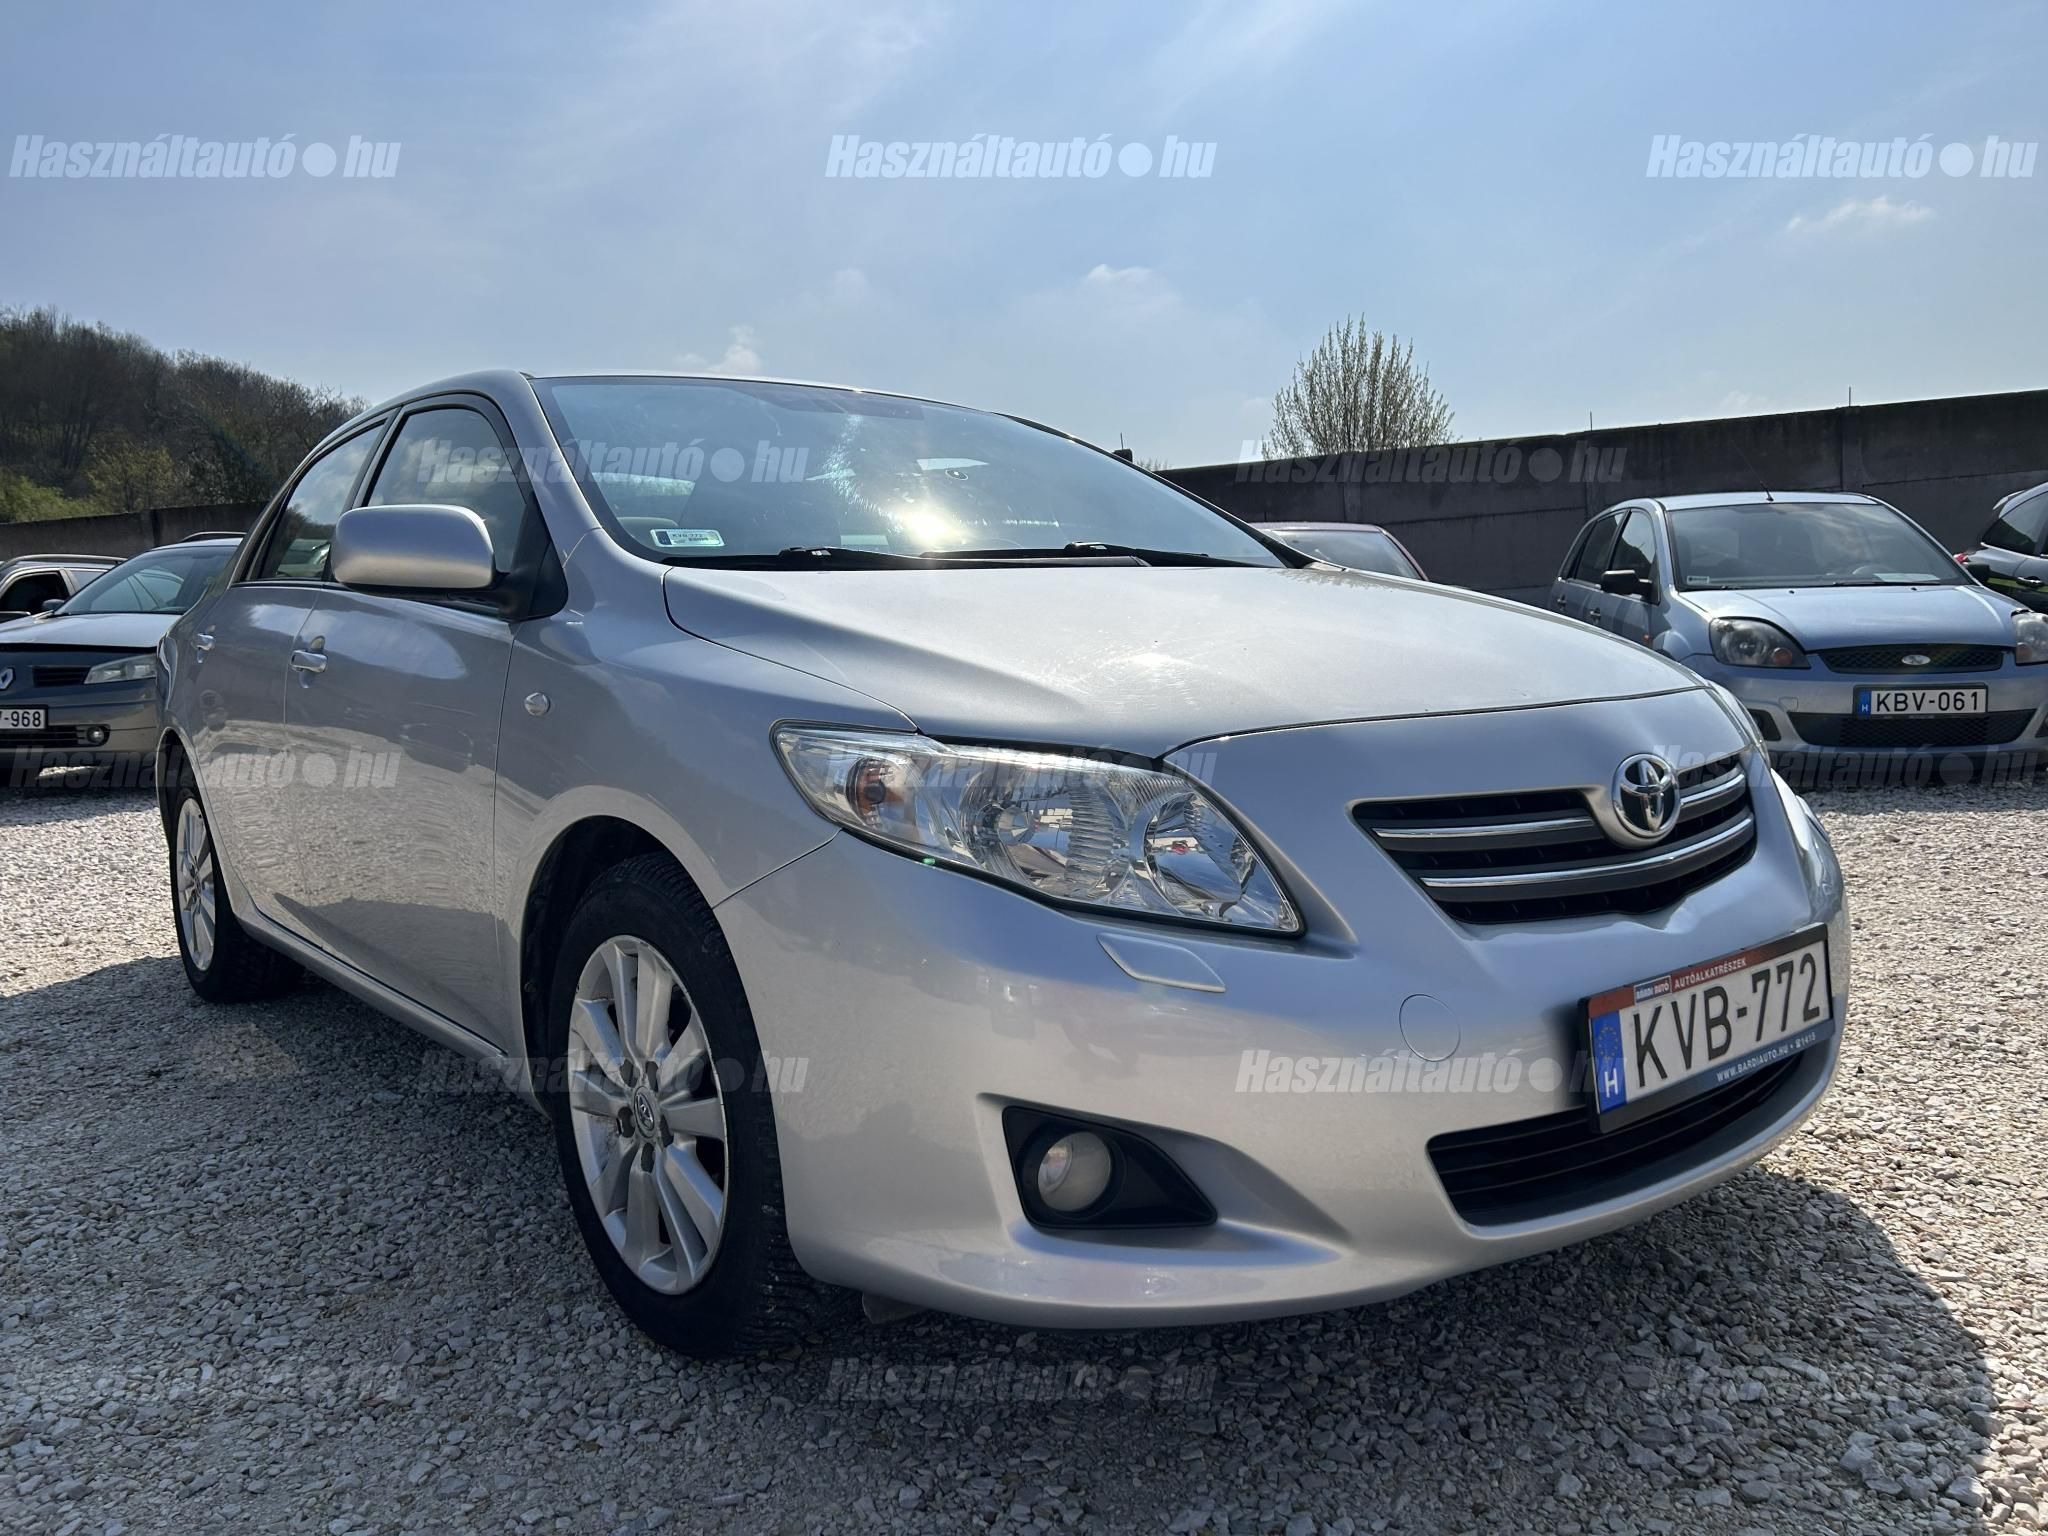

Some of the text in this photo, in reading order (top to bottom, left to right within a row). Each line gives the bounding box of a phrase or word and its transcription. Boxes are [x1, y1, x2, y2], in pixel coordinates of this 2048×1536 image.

[1861, 691, 1978, 712] H KBV-061
[0, 711, 42, 728] -968
[1674, 957, 1748, 990] AUTÓALKATRÉSZEK
[1604, 952, 1821, 1098] H KVB-772
